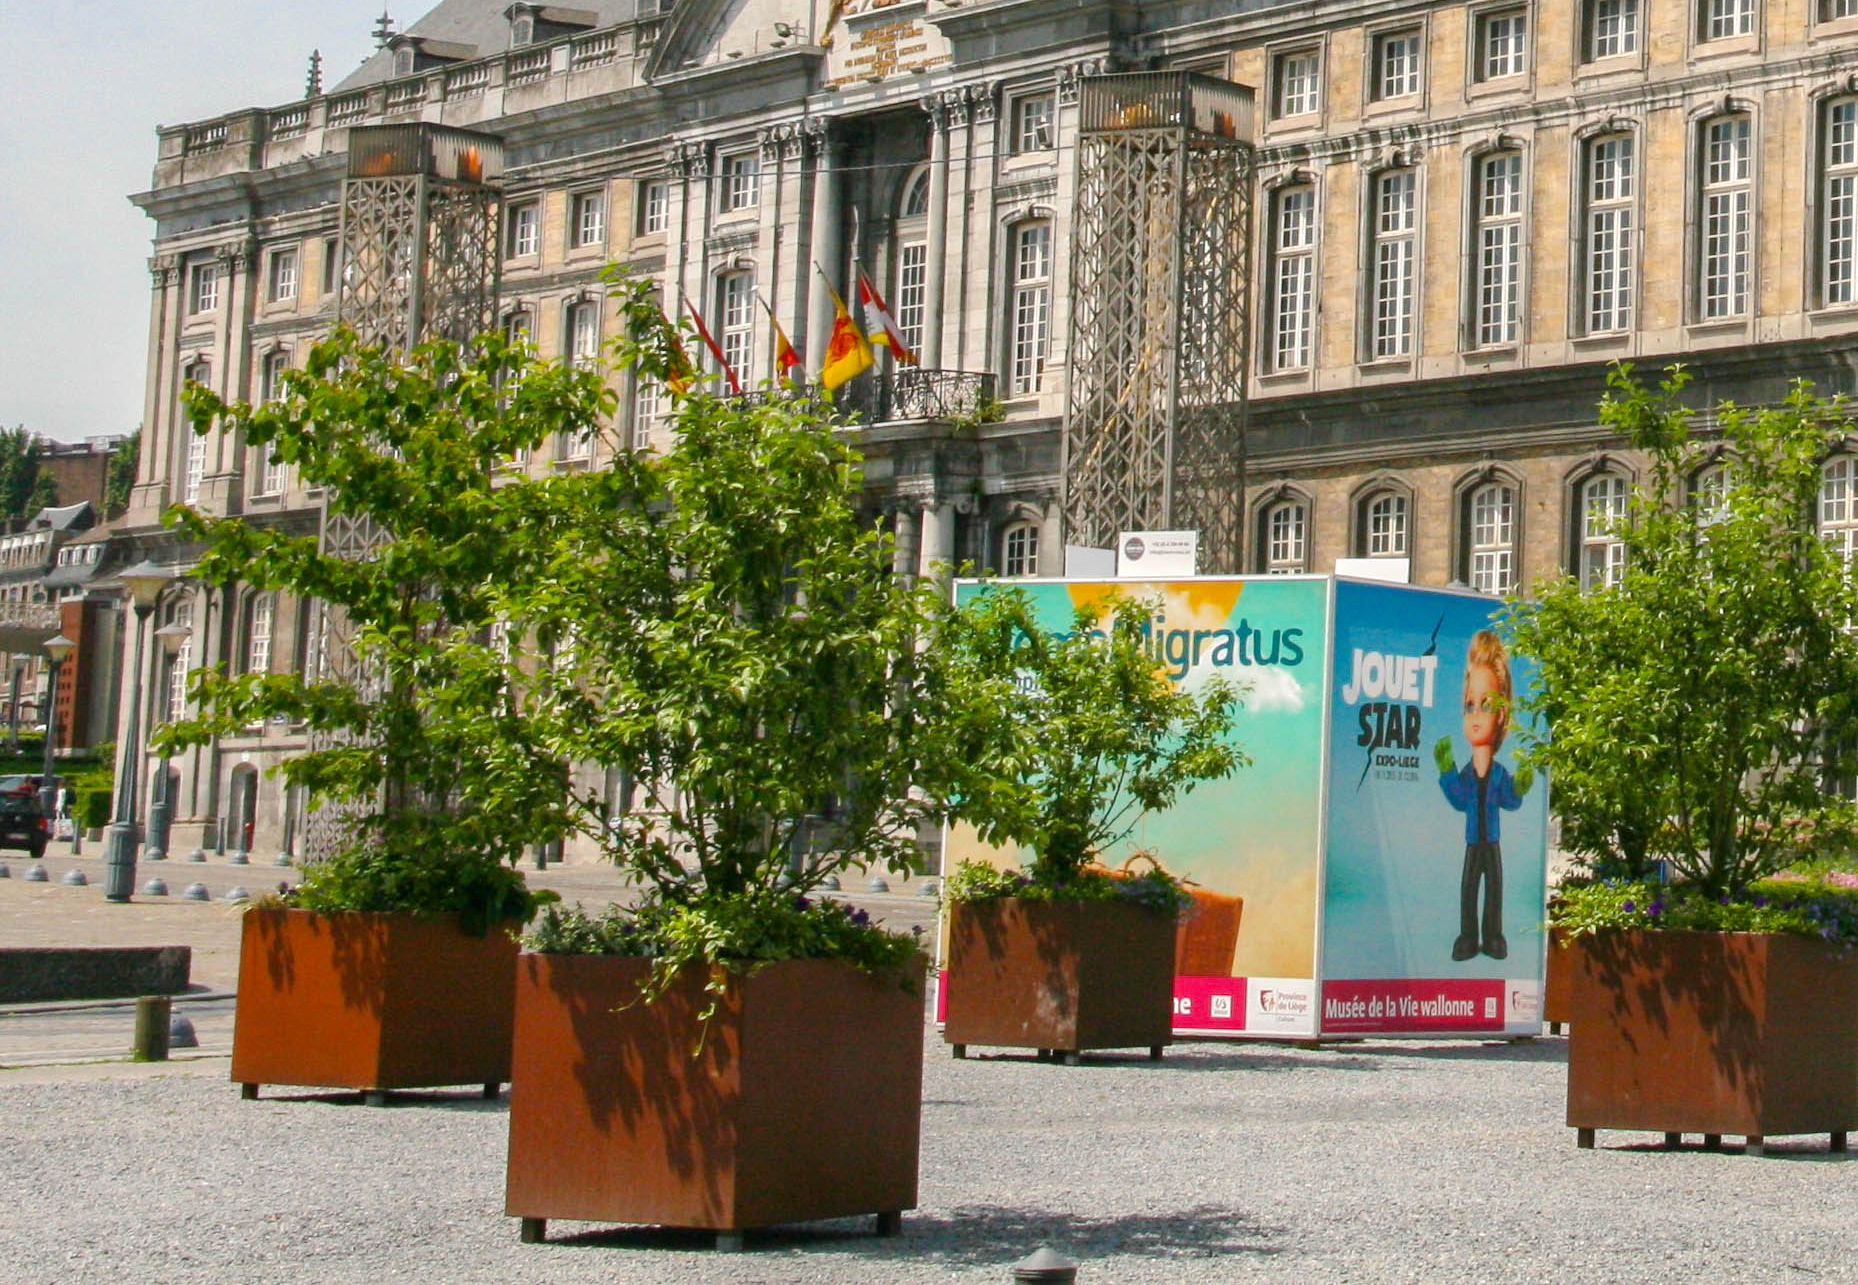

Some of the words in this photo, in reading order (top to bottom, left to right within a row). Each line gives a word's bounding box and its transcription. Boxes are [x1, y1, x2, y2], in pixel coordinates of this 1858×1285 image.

[1342, 648, 1438, 708] JOUET
[1357, 702, 1421, 750] STAR
[1325, 995, 1366, 1019] Musée
[1368, 995, 1384, 1018] de
[1386, 995, 1397, 1017] la
[1399, 995, 1419, 1017] Vie
[1420, 994, 1475, 1017] wallonne
